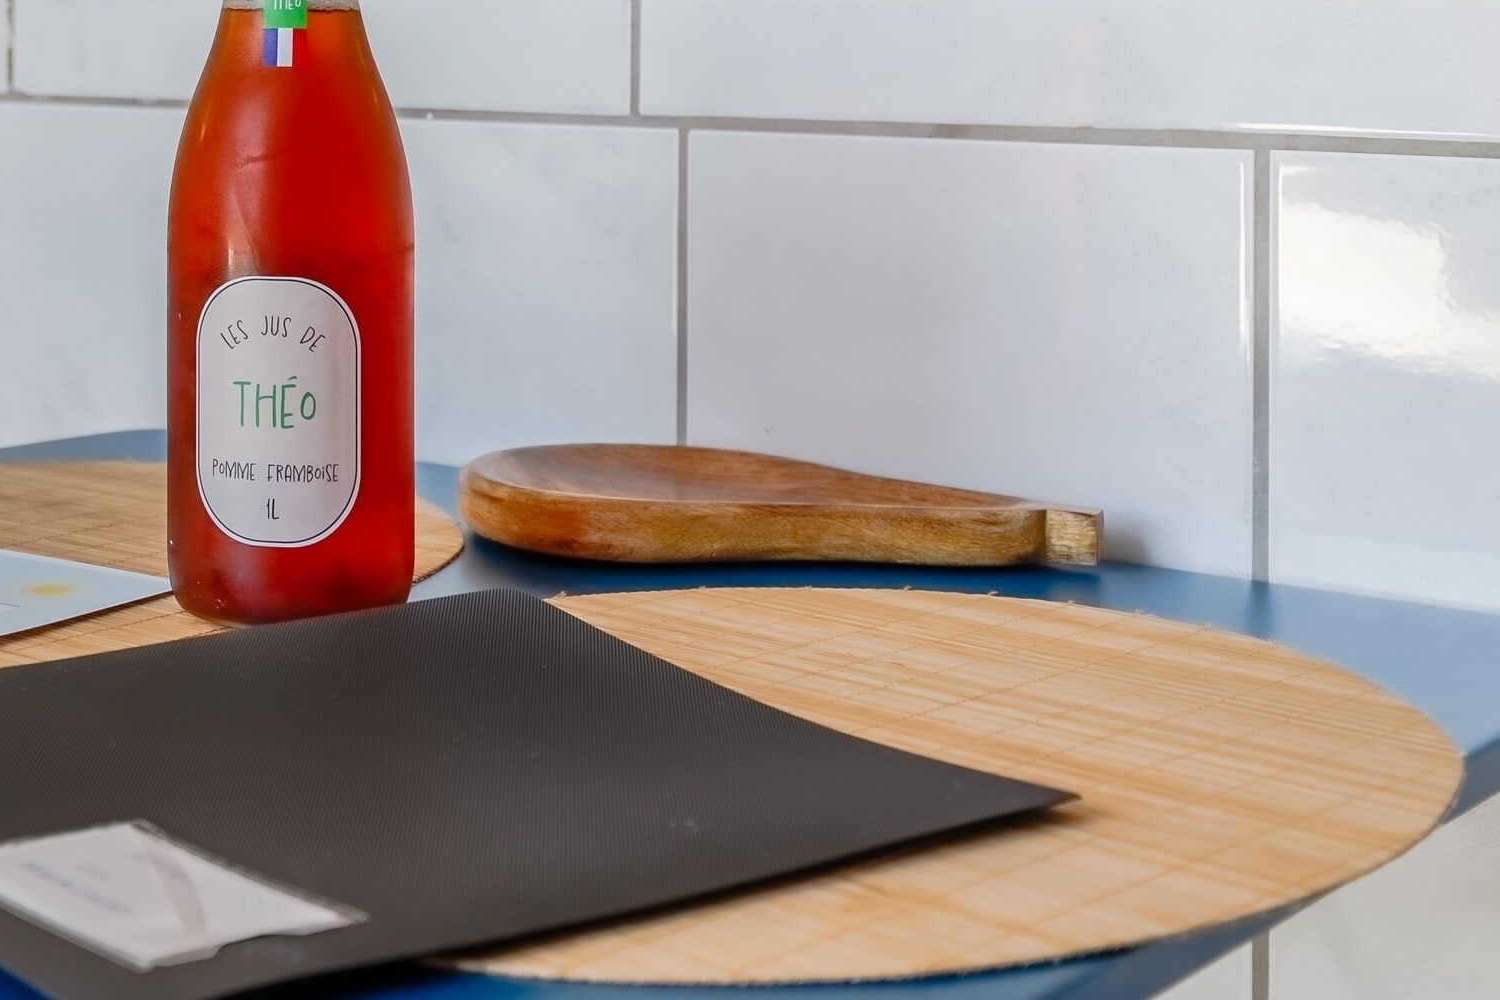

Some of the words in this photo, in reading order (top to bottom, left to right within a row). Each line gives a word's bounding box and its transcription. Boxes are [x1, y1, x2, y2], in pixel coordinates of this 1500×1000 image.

[220, 319, 248, 349] LES
[261, 315, 292, 338] JUS
[300, 326, 326, 352] DE
[232, 375, 316, 429] THÉO
[212, 458, 256, 481] POMME
[266, 498, 280, 520] 1L
